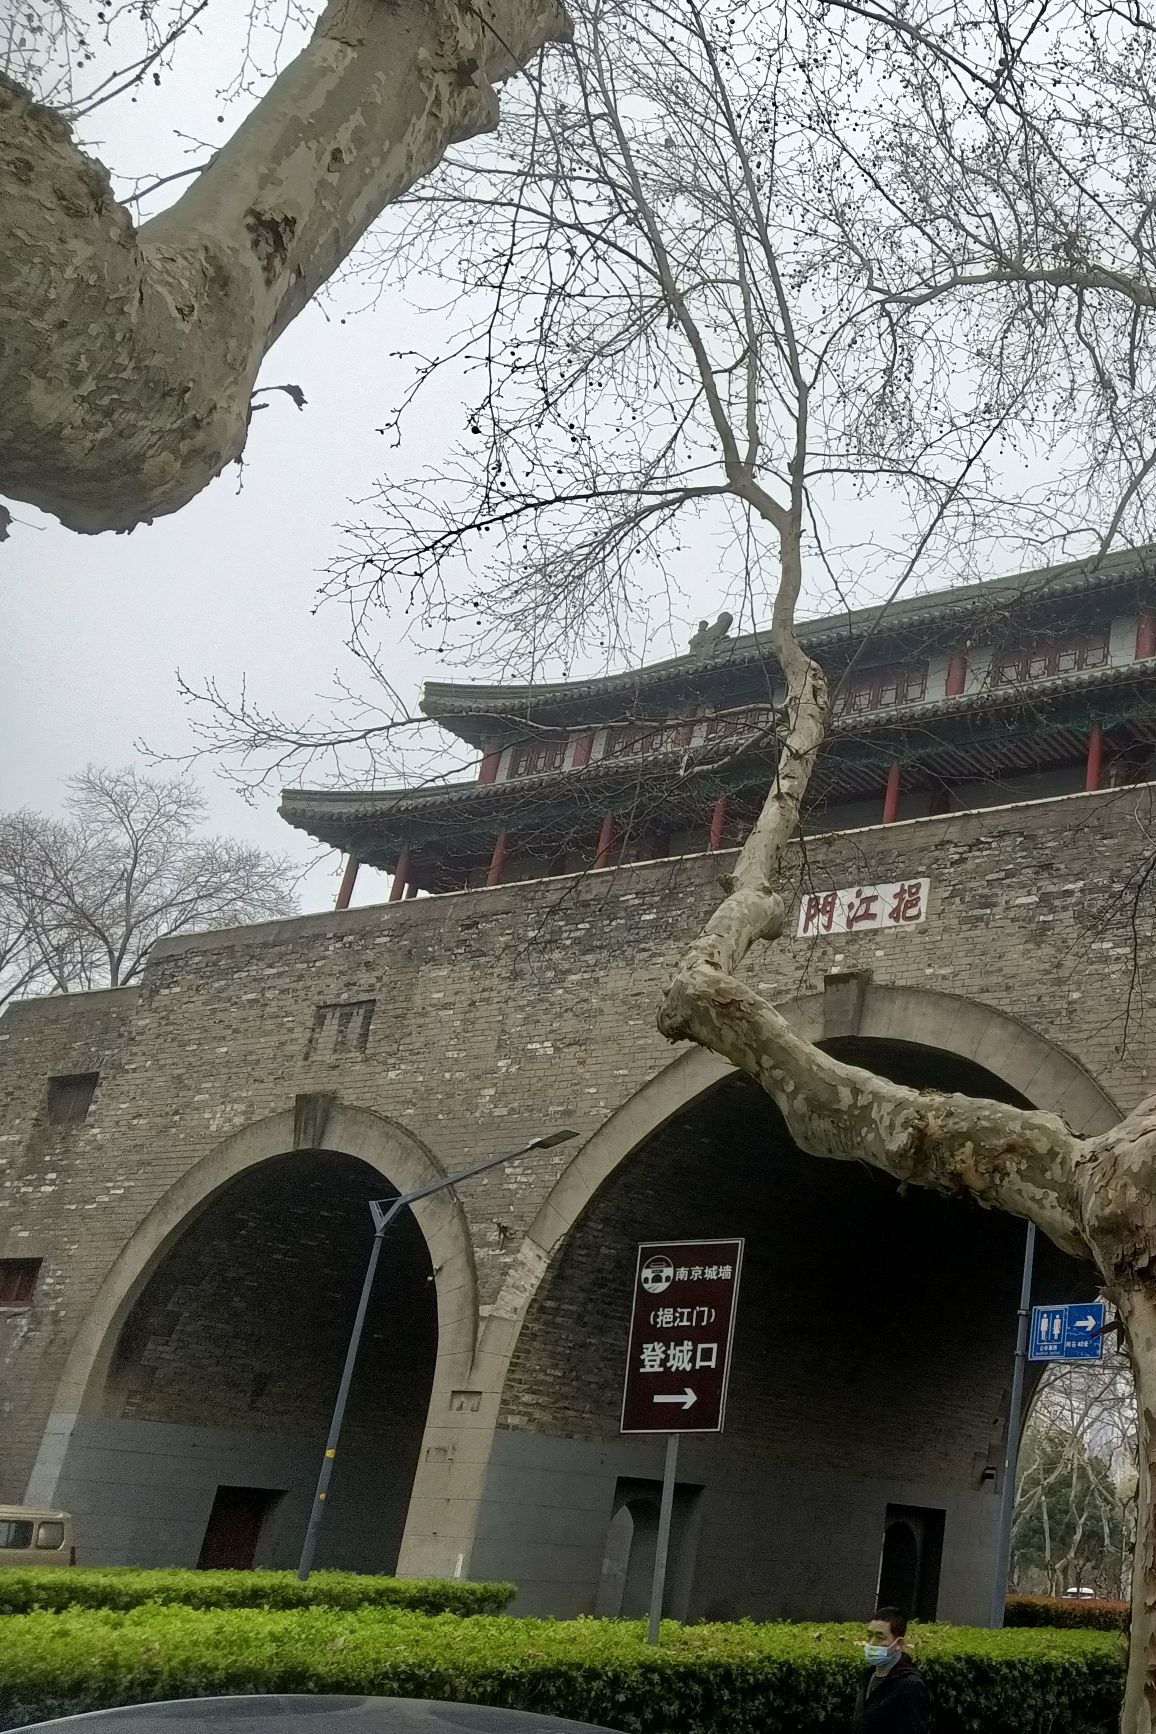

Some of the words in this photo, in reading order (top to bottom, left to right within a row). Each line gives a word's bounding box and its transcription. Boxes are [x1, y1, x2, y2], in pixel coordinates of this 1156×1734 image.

[675, 1265, 733, 1282] 南京城墙
[639, 1340, 718, 1373] 登城口
